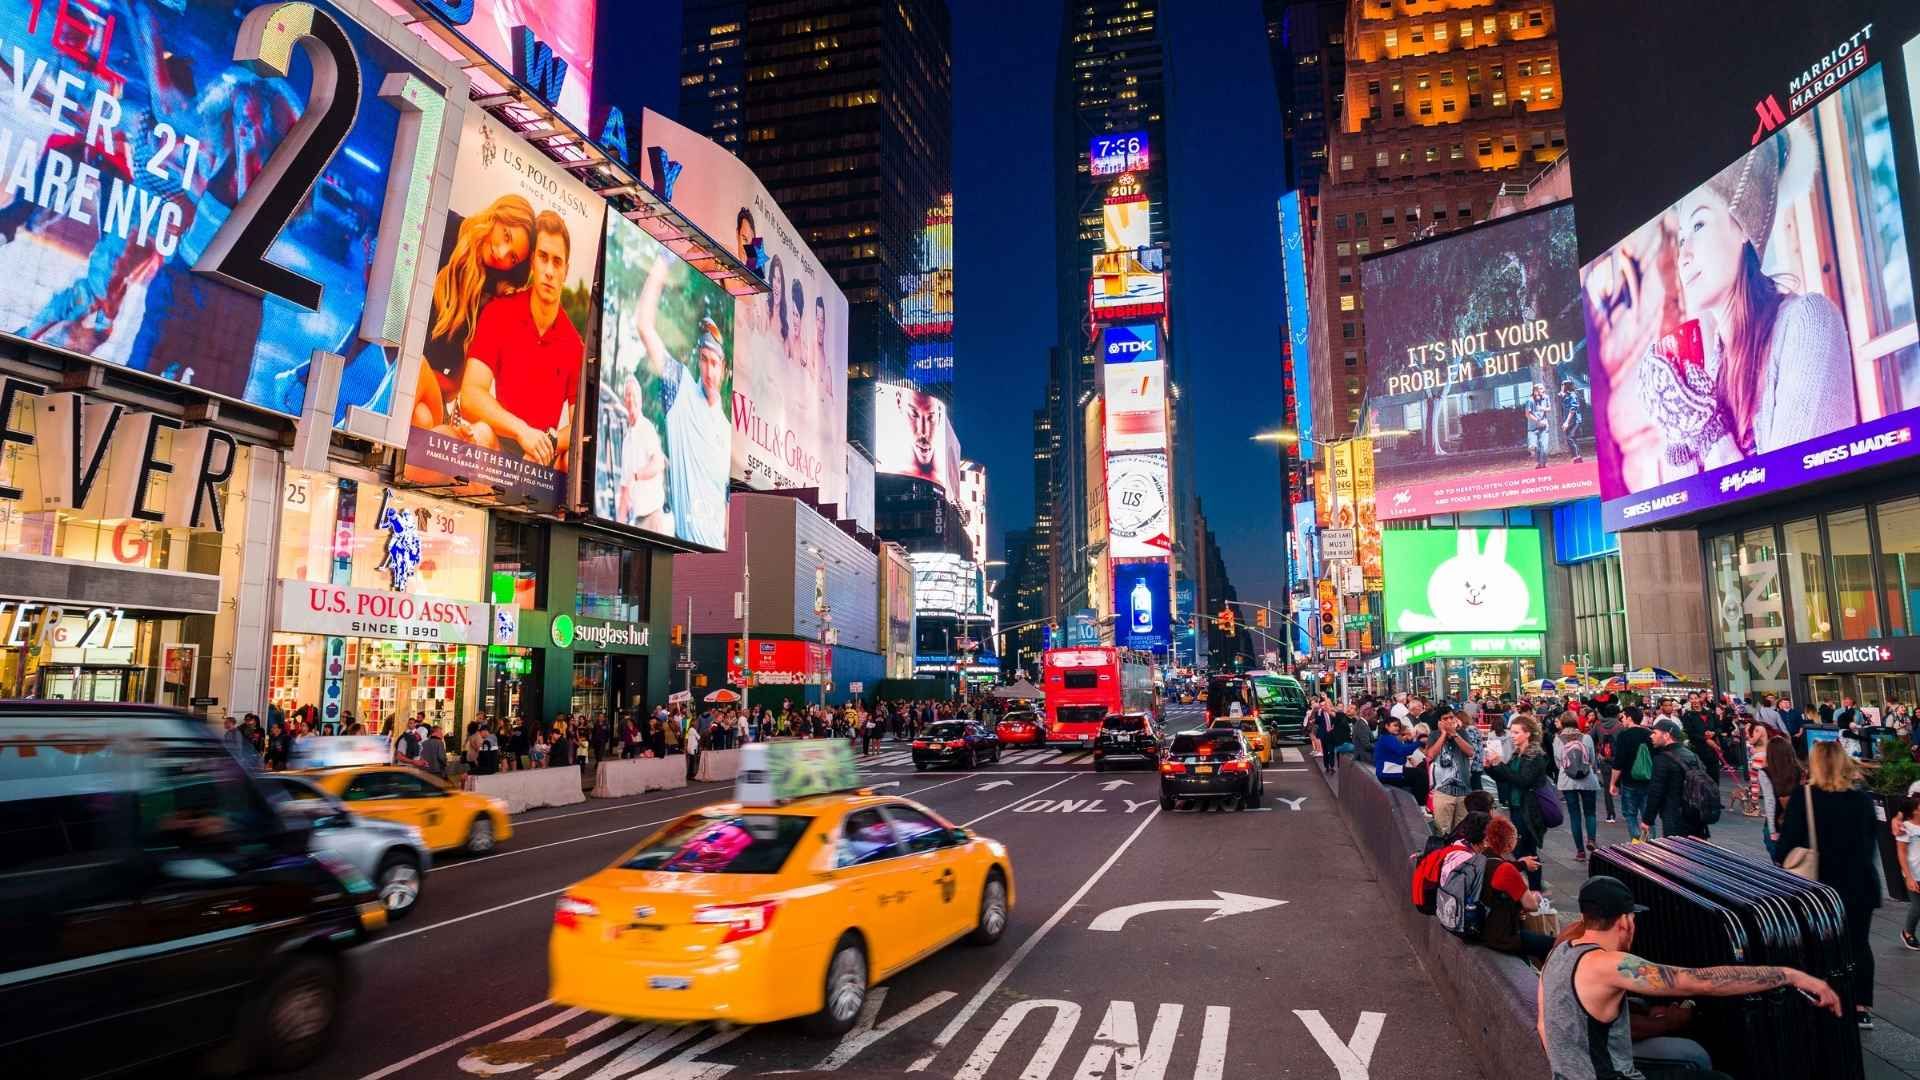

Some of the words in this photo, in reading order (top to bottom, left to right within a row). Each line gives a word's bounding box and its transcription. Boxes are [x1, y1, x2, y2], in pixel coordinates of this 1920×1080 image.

[27, 0, 127, 84] EL
[1789, 23, 1873, 95] MARRIOTT
[1791, 50, 1865, 111] MARQUIS
[0, 40, 122, 155] VER
[146, 122, 200, 191] 21
[1099, 137, 1140, 156] 7:36
[192, 1, 447, 345] 21
[503, 147, 524, 174] U.S.
[527, 163, 557, 196] POLO
[559, 188, 589, 218] ASSN.
[1111, 184, 1141, 197] 2017
[103, 177, 182, 257] NYC
[1118, 340, 1153, 353] TDK
[1407, 342, 1446, 368] IT'S
[1451, 332, 1488, 358] NOT
[1495, 319, 1549, 348] YOUR
[1388, 362, 1473, 396] PROBLEM
[1485, 352, 1521, 378] BUT
[1534, 341, 1574, 367] YOU
[429, 436, 458, 455] LIVE
[466, 449, 554, 481] AUTHENTICALLY
[1803, 444, 1849, 470] SWISS
[1850, 430, 1899, 457] MADE
[1651, 493, 1681, 511] MADE
[436, 515, 455, 535] $30
[0, 602, 63, 648] ER
[310, 587, 350, 614] U.S.
[357, 593, 414, 619] POLO
[419, 604, 472, 626] ASSN.
[352, 621, 397, 634] SINCE
[405, 626, 438, 638] 1890
[575, 621, 629, 649] sunglass
[629, 624, 649, 647] hut
[1822, 645, 1880, 664] swatch
[1013, 799, 1160, 813] ONLY
[953, 998, 1387, 1080] ONLY
